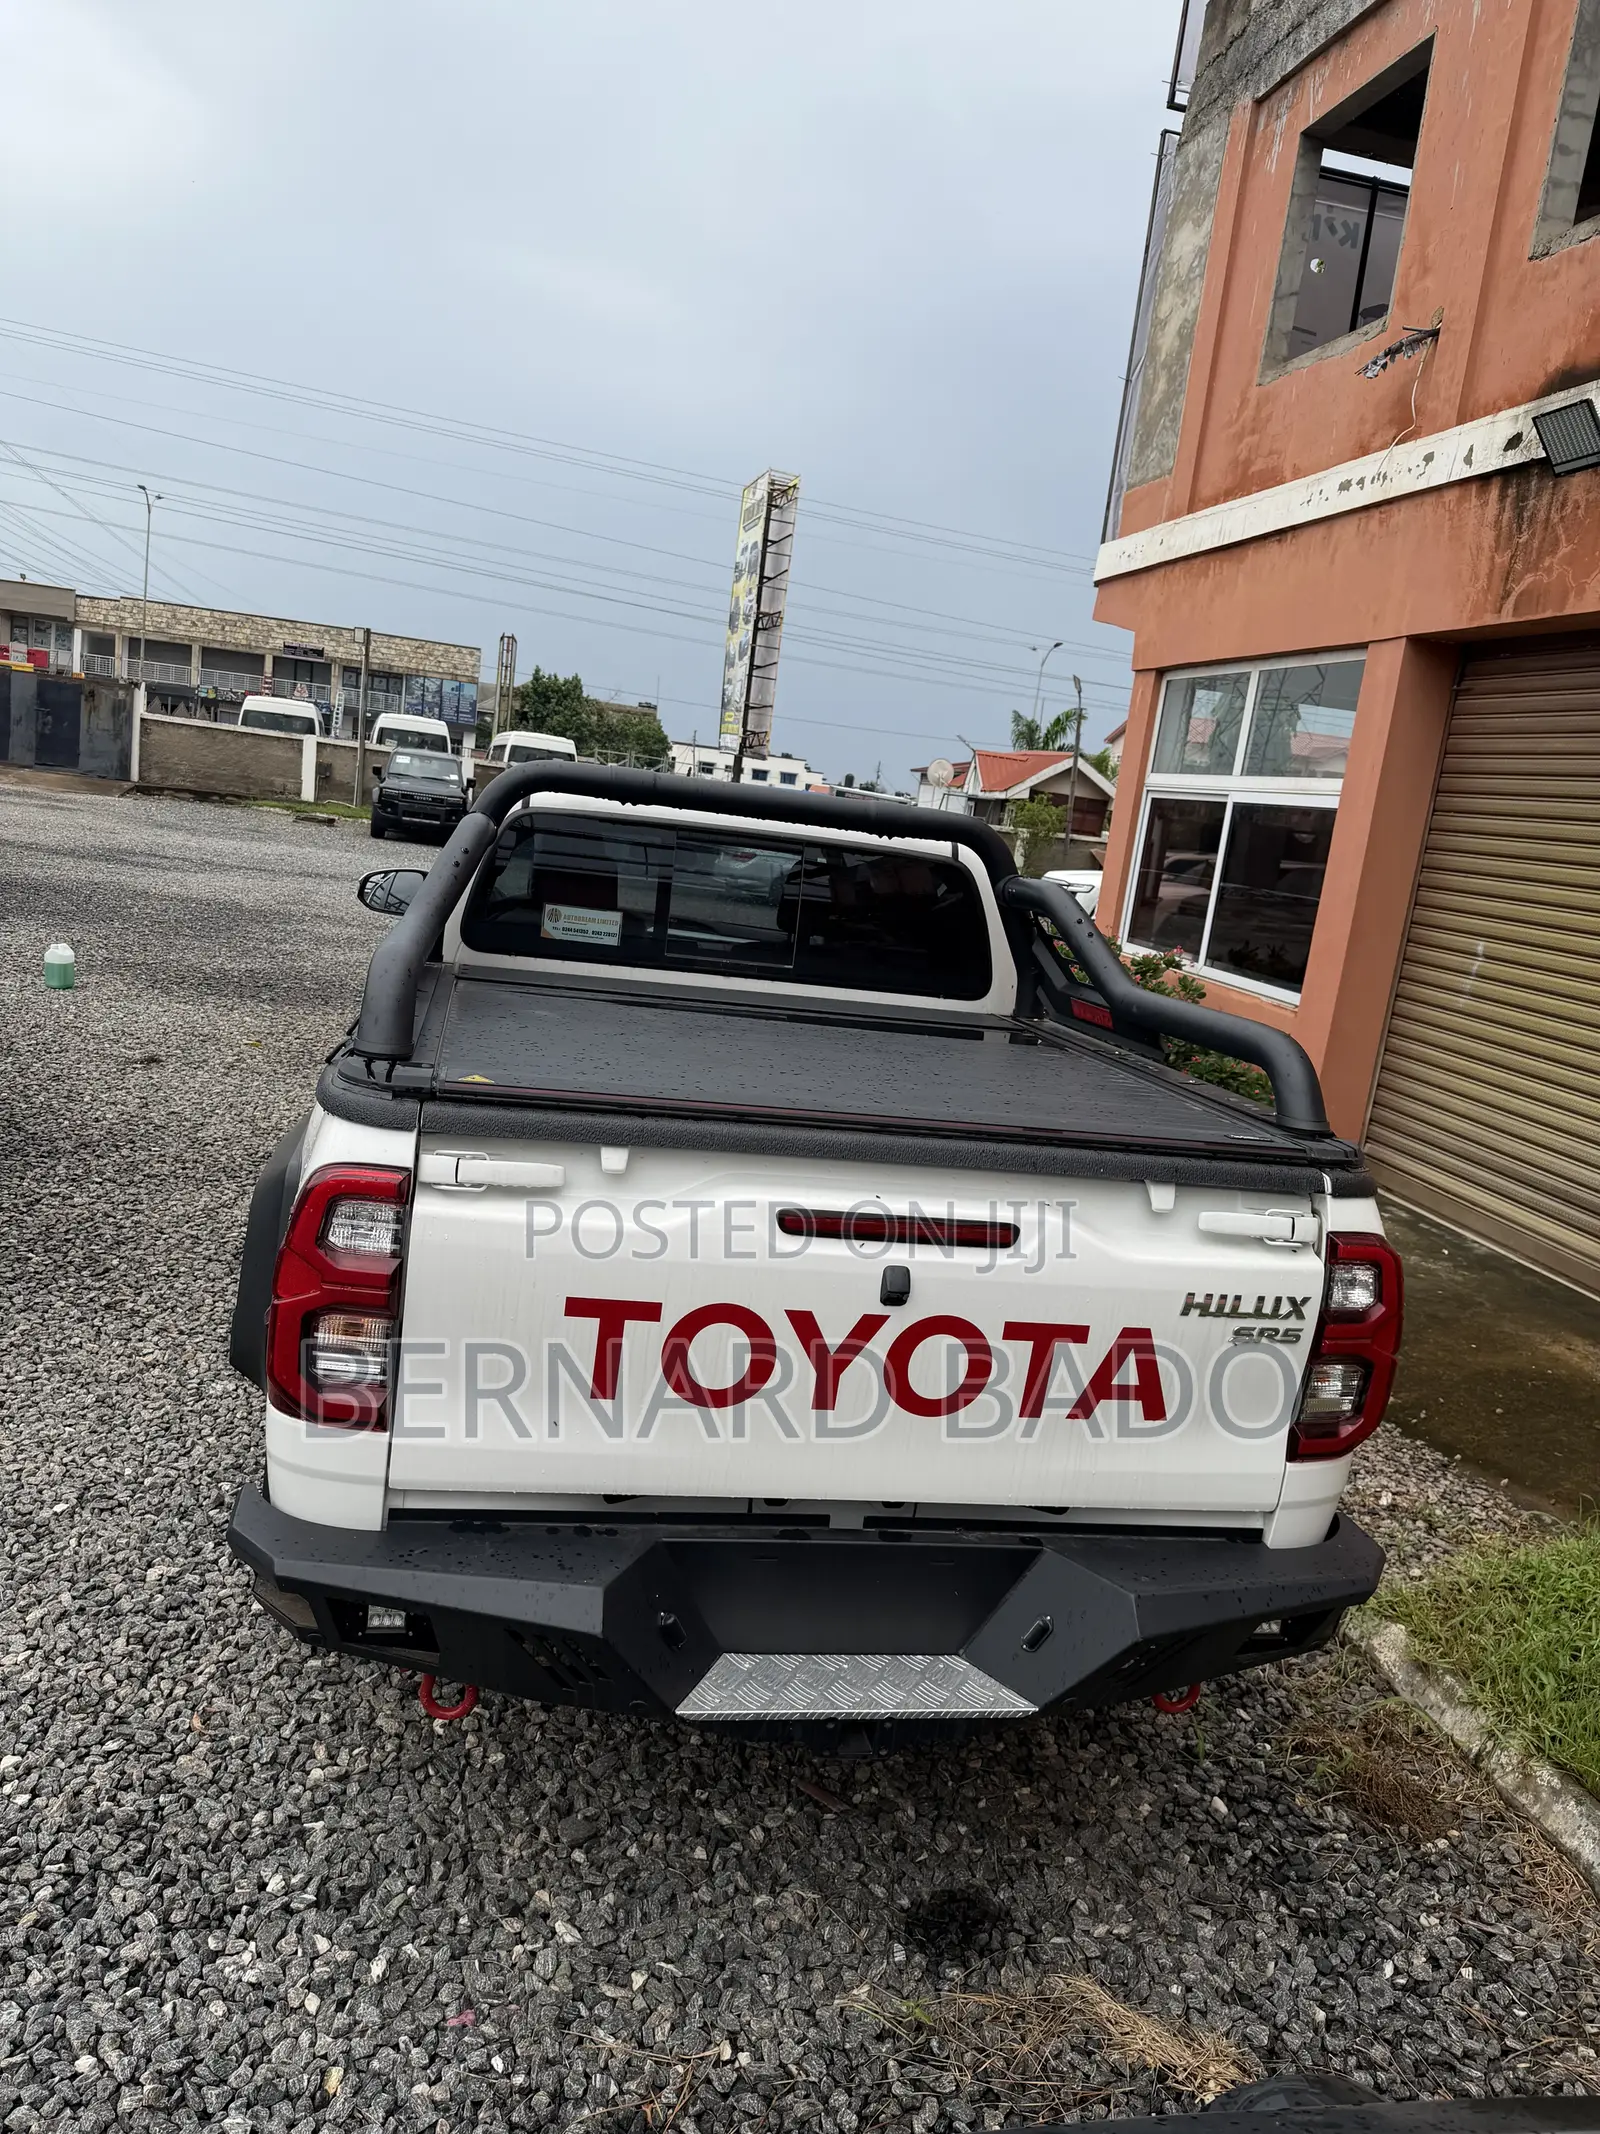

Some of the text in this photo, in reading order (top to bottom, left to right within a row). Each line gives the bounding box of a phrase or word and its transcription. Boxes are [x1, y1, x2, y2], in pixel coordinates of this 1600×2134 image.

[597, 918, 619, 926] LIMITED
[1180, 1292, 1312, 1320] HILUX
[1227, 1326, 1304, 1344] SR5
[564, 1296, 1168, 1422] TOYOTA
